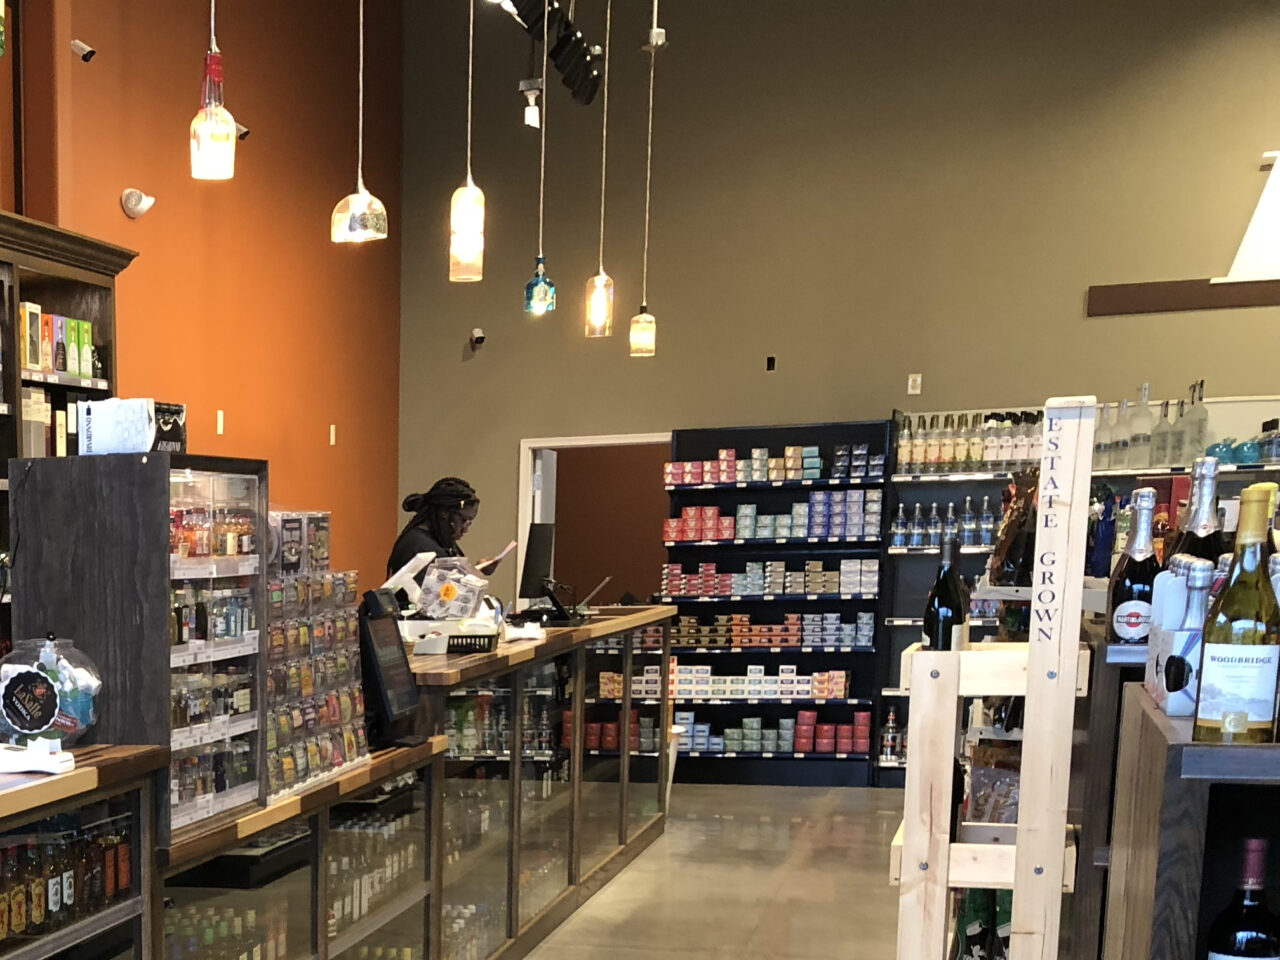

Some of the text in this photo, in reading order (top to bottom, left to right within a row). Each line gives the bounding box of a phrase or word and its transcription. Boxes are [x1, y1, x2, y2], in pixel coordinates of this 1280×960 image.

[1034, 416, 1063, 643] ESTATE GROWN
[1210, 655, 1272, 664] WOODBRIDGE
